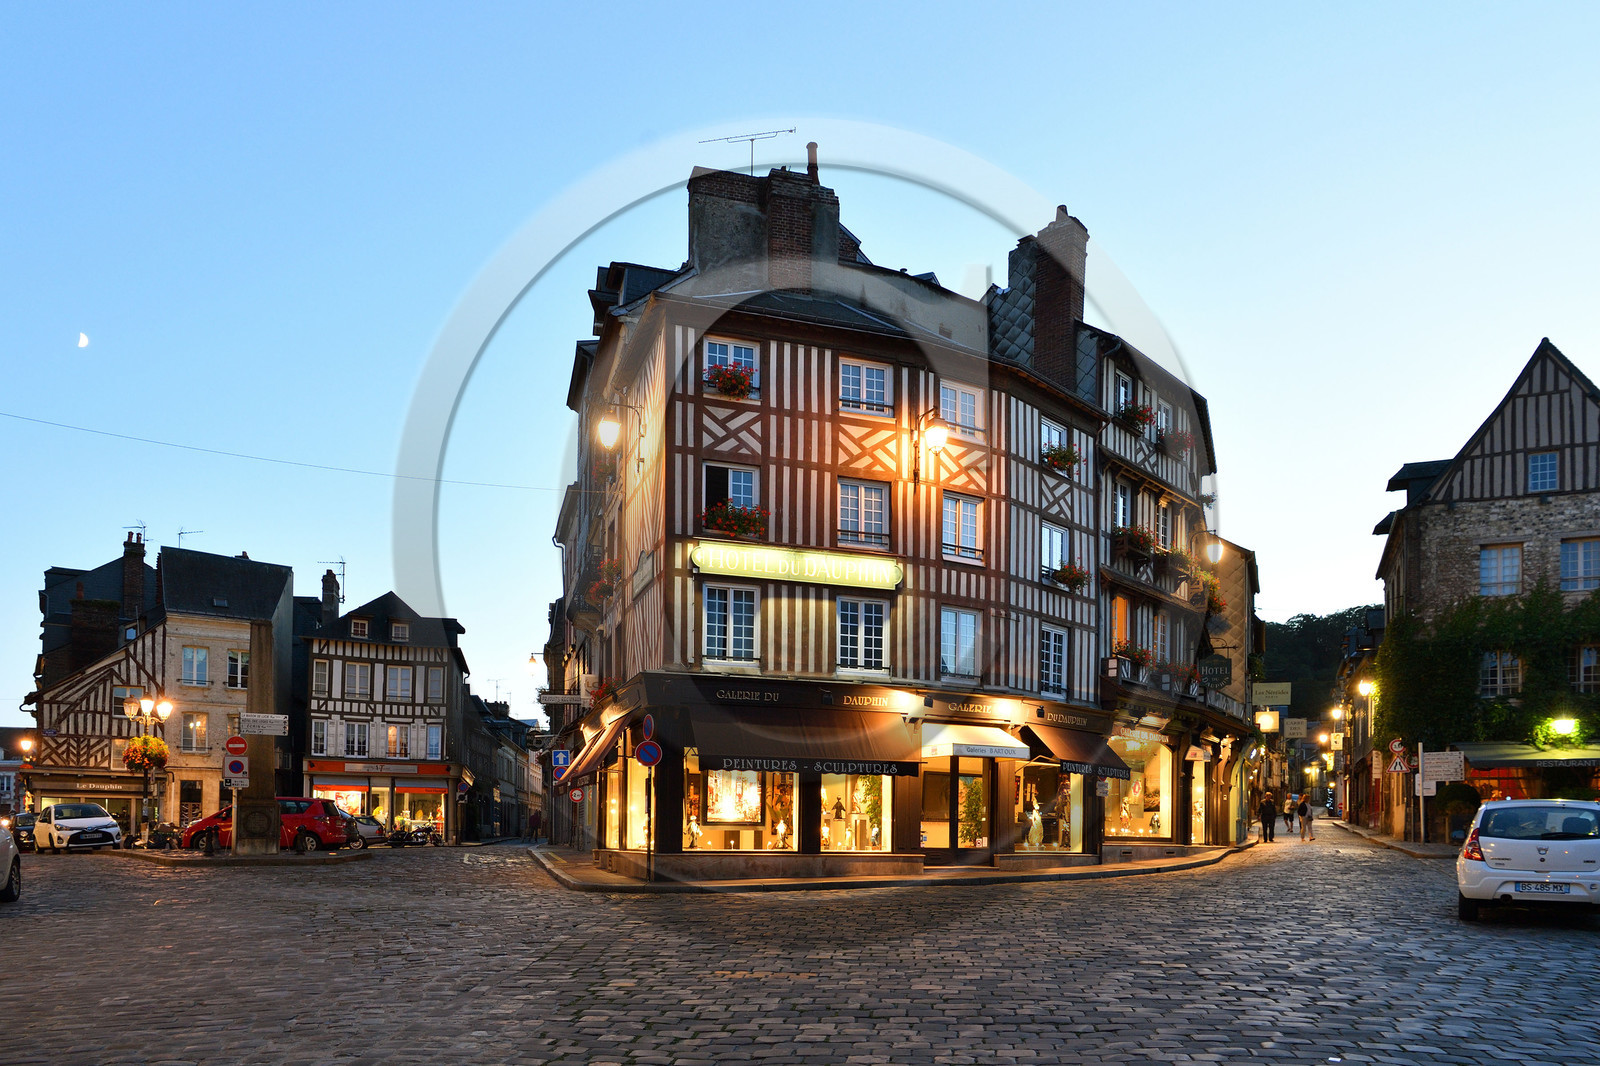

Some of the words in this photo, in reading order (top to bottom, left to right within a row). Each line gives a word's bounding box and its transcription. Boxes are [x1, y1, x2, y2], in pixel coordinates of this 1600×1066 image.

[779, 559, 800, 576] DU
[804, 556, 891, 583] DAUPHIN
[1201, 666, 1230, 675] HOTEL
[1202, 676, 1230, 689] DAUPHIN
[716, 689, 760, 701] GALERIE
[764, 692, 780, 702] DU
[843, 695, 889, 707] DAUPHIN
[948, 702, 992, 714] GALERIE
[1047, 713, 1059, 723] DU
[1058, 714, 1088, 727] DAUPHIN
[966, 746, 987, 754] Galeries
[989, 747, 1017, 756] BARTOUX
[723, 758, 797, 771] PEINTURES
[813, 761, 898, 774] SCULPTURES
[1062, 761, 1093, 774] PEINTURES
[1097, 766, 1130, 779] SCULPTURES
[1536, 759, 1597, 768] RESTAURANT
[88, 783, 123, 791] Dauphin
